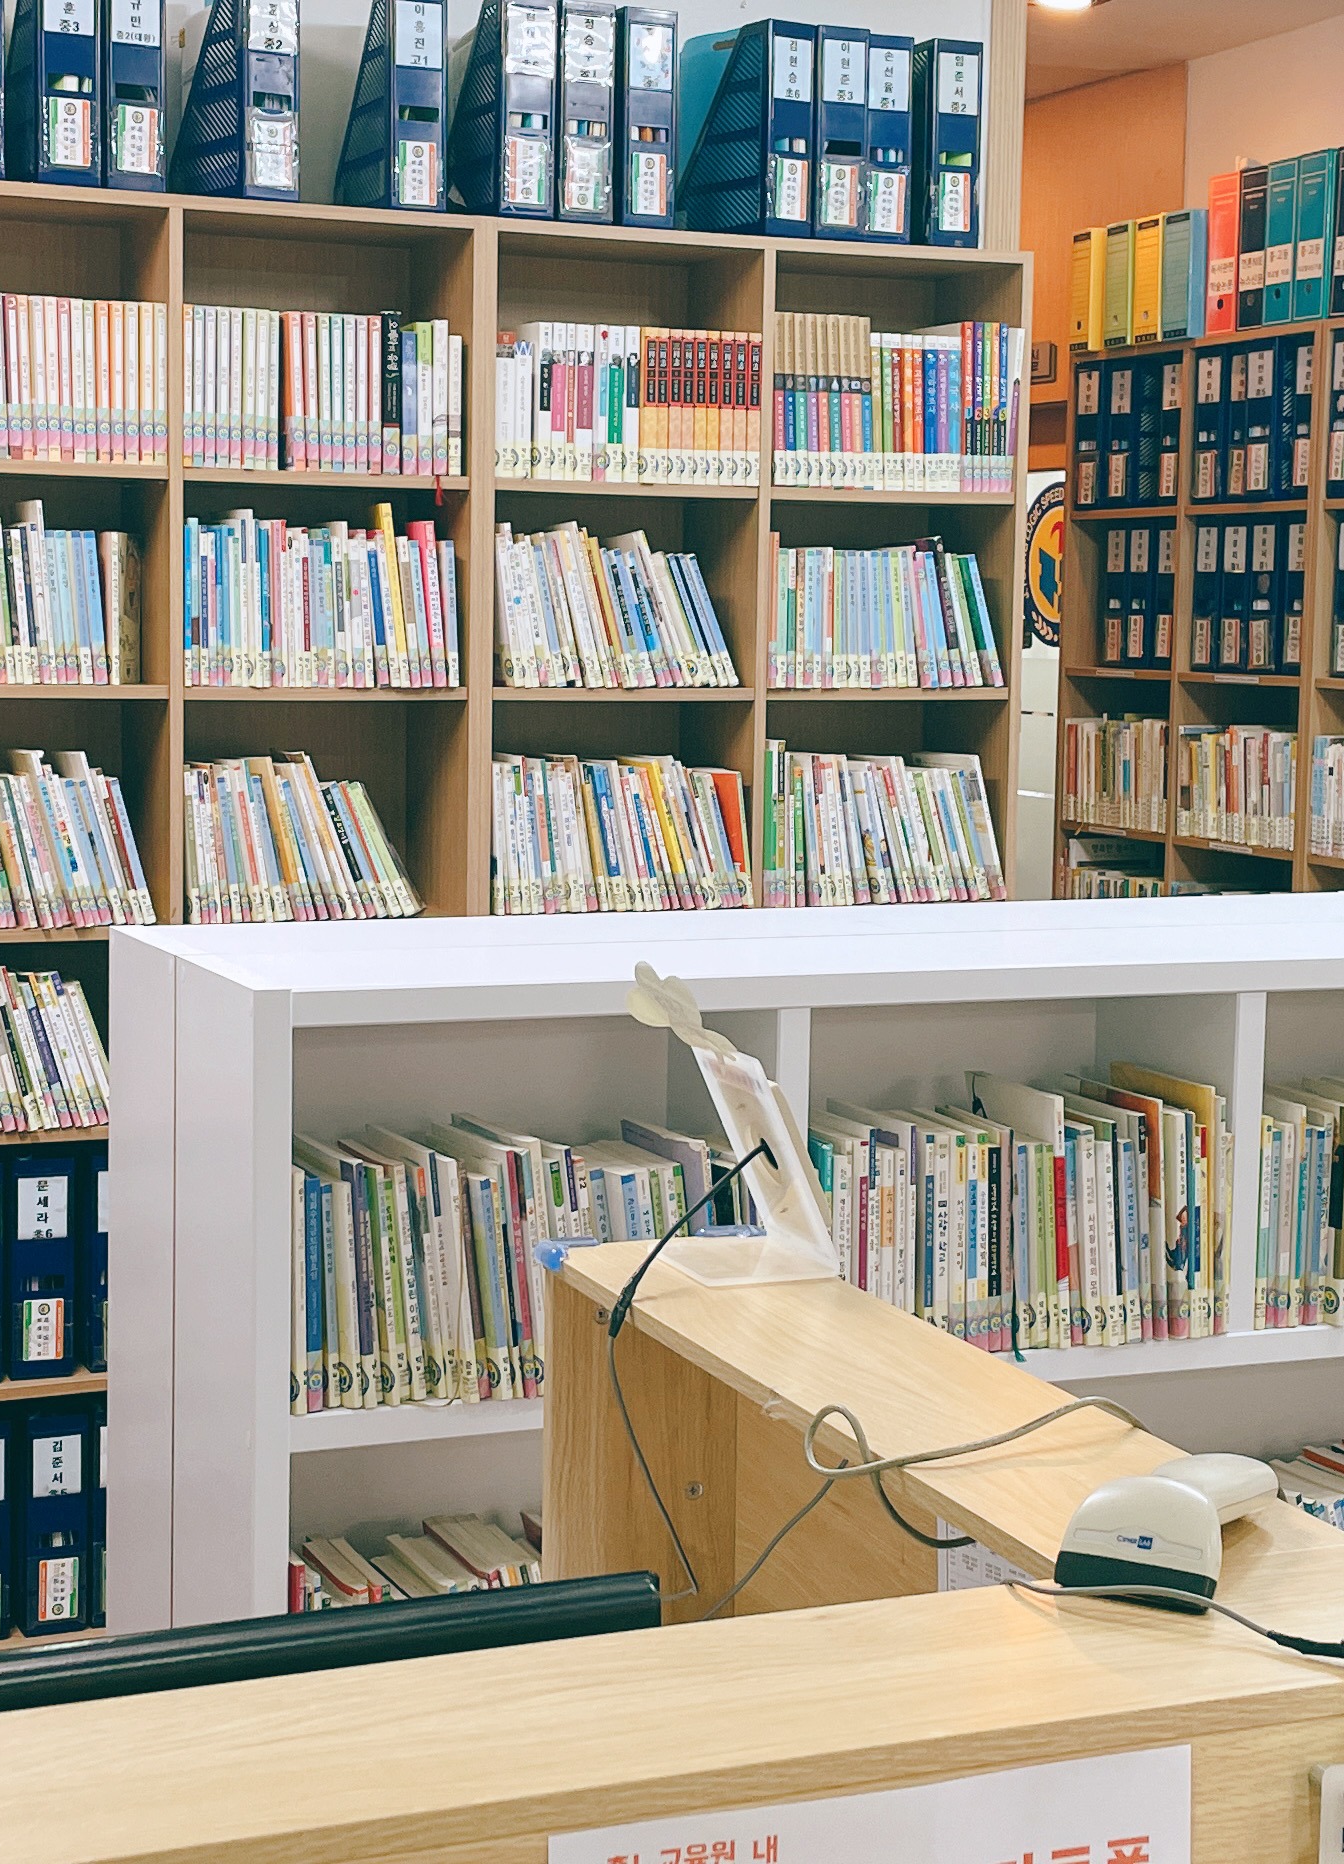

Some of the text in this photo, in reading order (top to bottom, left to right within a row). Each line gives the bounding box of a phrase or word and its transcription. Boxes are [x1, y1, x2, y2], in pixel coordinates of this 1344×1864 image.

[59, 19, 80, 32] 중3
[410, 54, 428, 66] 고1
[387, 354, 400, 371] 유령
[37, 1181, 48, 1223] 문세라
[32, 1228, 52, 1238] 초6
[52, 1440, 63, 1483] 김준서
